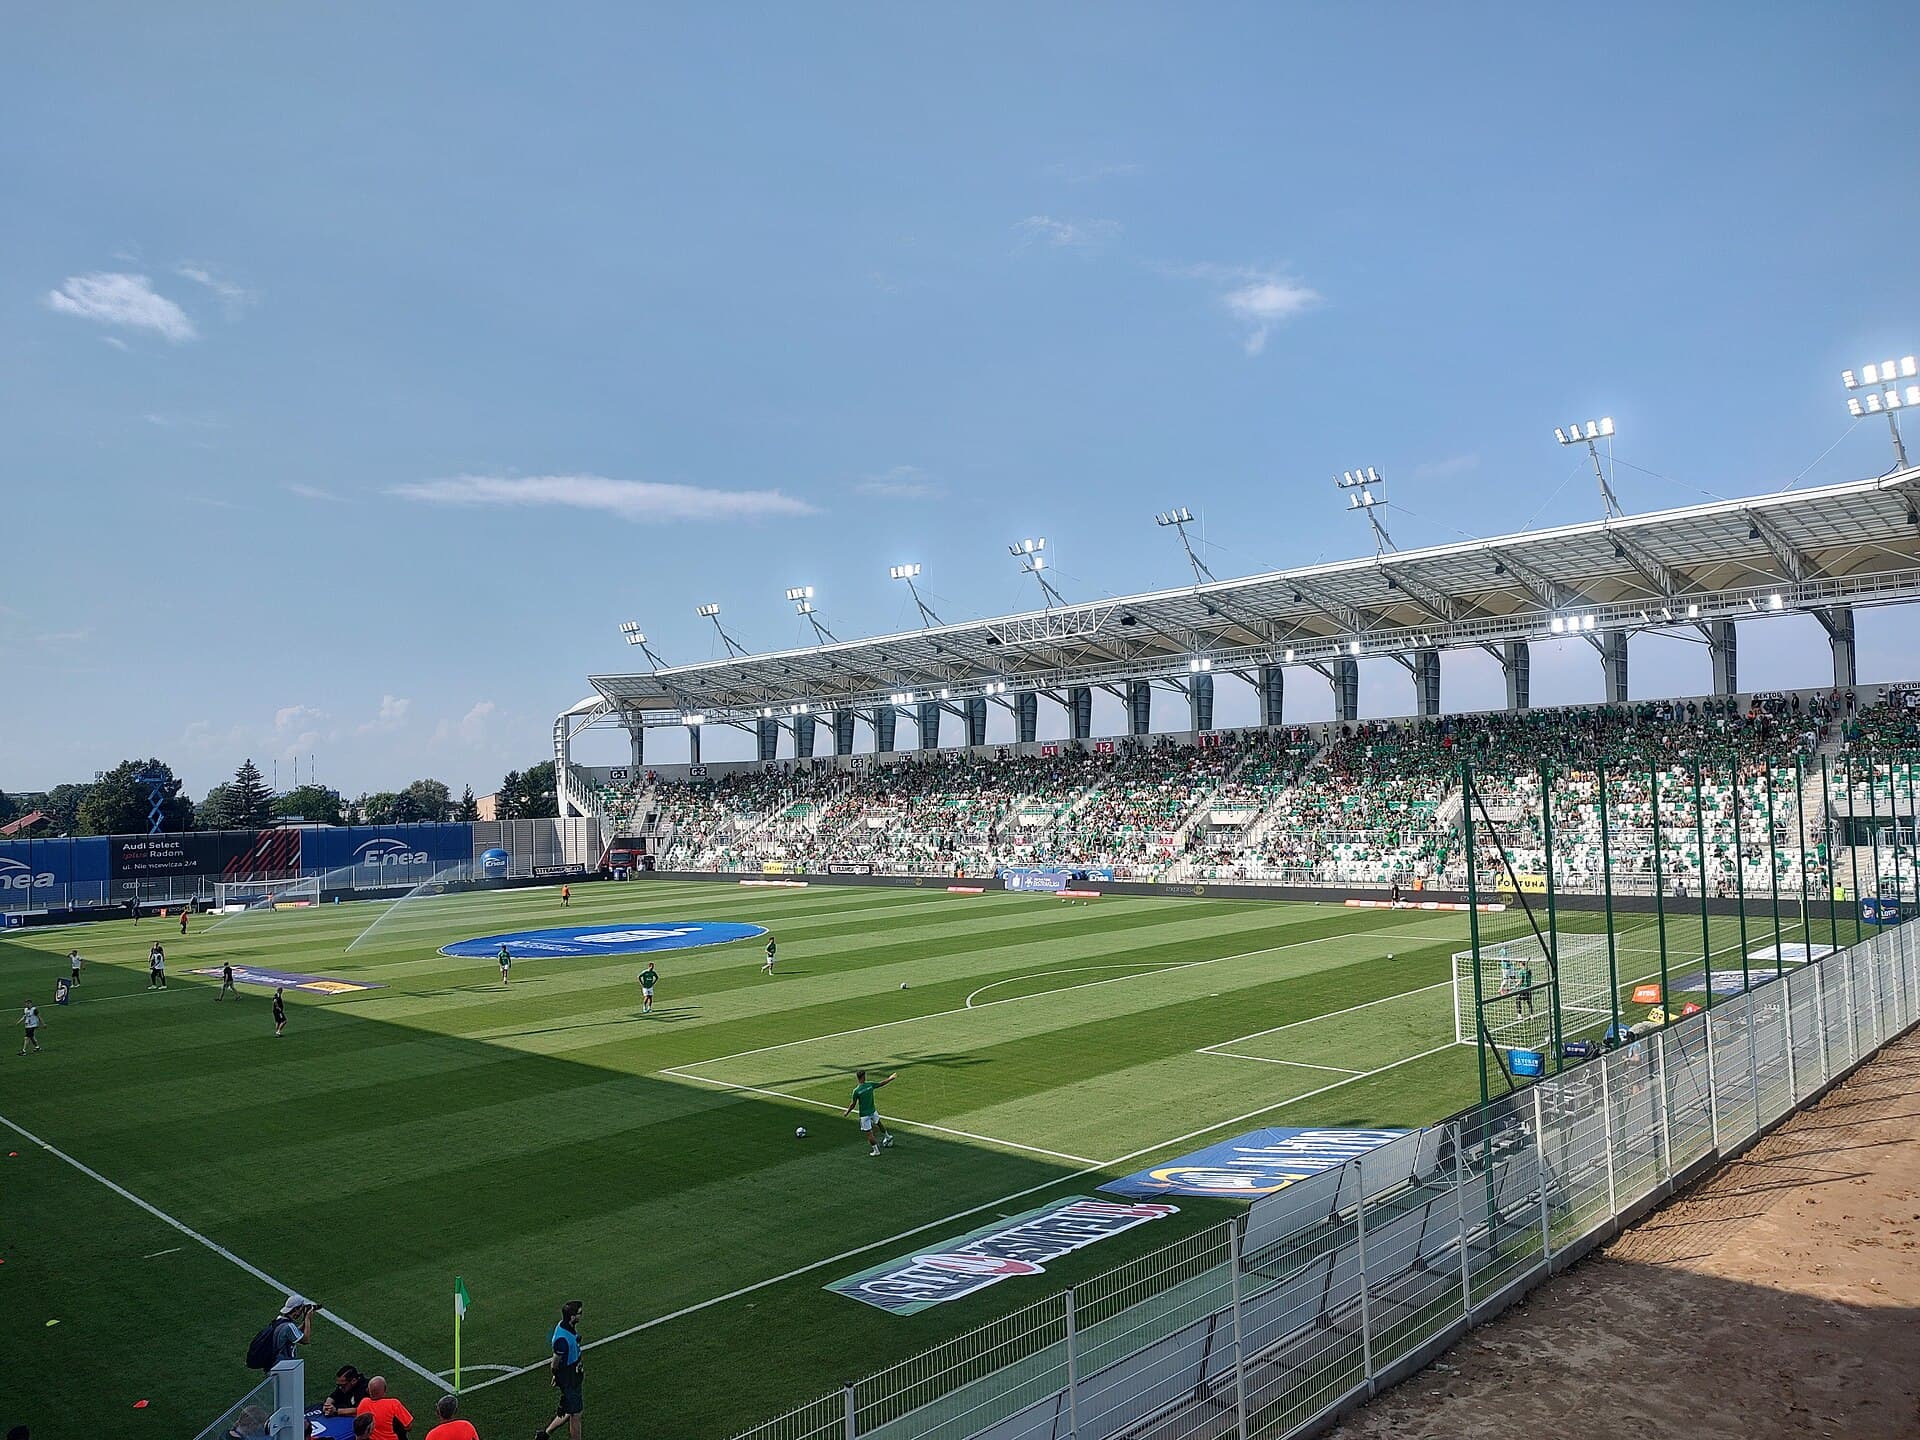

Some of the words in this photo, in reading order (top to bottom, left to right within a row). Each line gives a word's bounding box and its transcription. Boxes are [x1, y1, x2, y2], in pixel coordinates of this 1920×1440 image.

[691, 768, 706, 776] G-2
[122, 842, 146, 850] Audi
[364, 849, 428, 867] Enea
